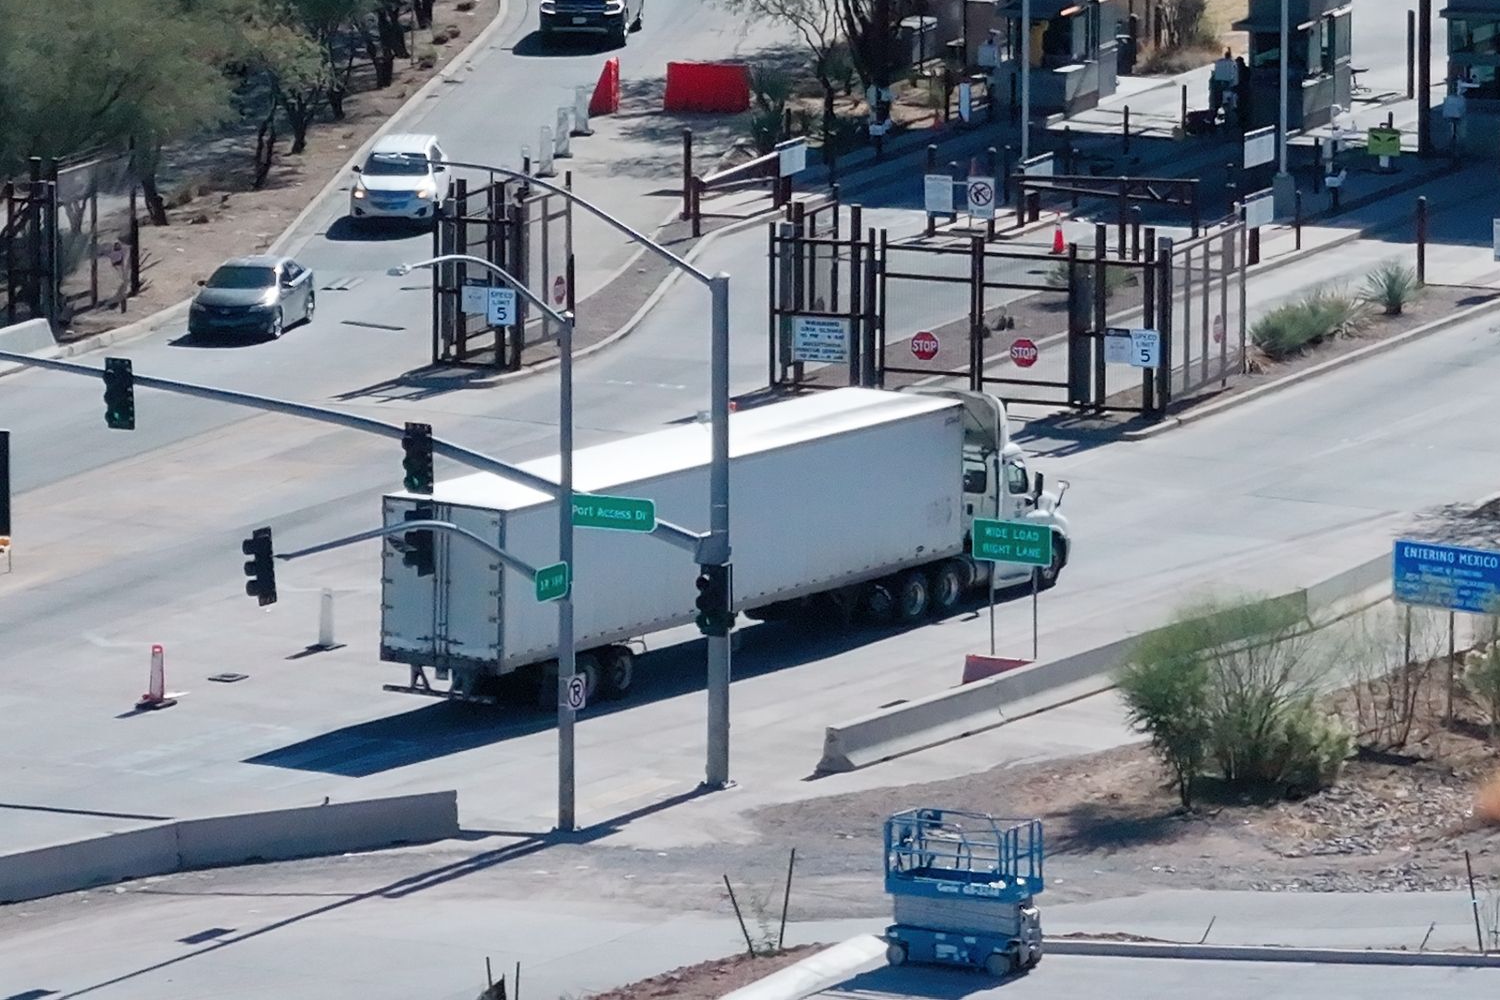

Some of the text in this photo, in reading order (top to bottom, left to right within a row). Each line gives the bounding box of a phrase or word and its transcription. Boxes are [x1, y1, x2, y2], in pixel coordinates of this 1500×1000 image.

[497, 306, 508, 321] 5
[911, 340, 937, 352] STOP
[1011, 346, 1037, 359] STOP
[1140, 348, 1151, 363] 5
[572, 504, 594, 517] Port
[596, 507, 632, 520] Access
[984, 526, 1040, 542] WIDE LOAD
[982, 542, 1041, 558] RIGHT LANE
[1403, 545, 1499, 569] ENTERING MEXICO
